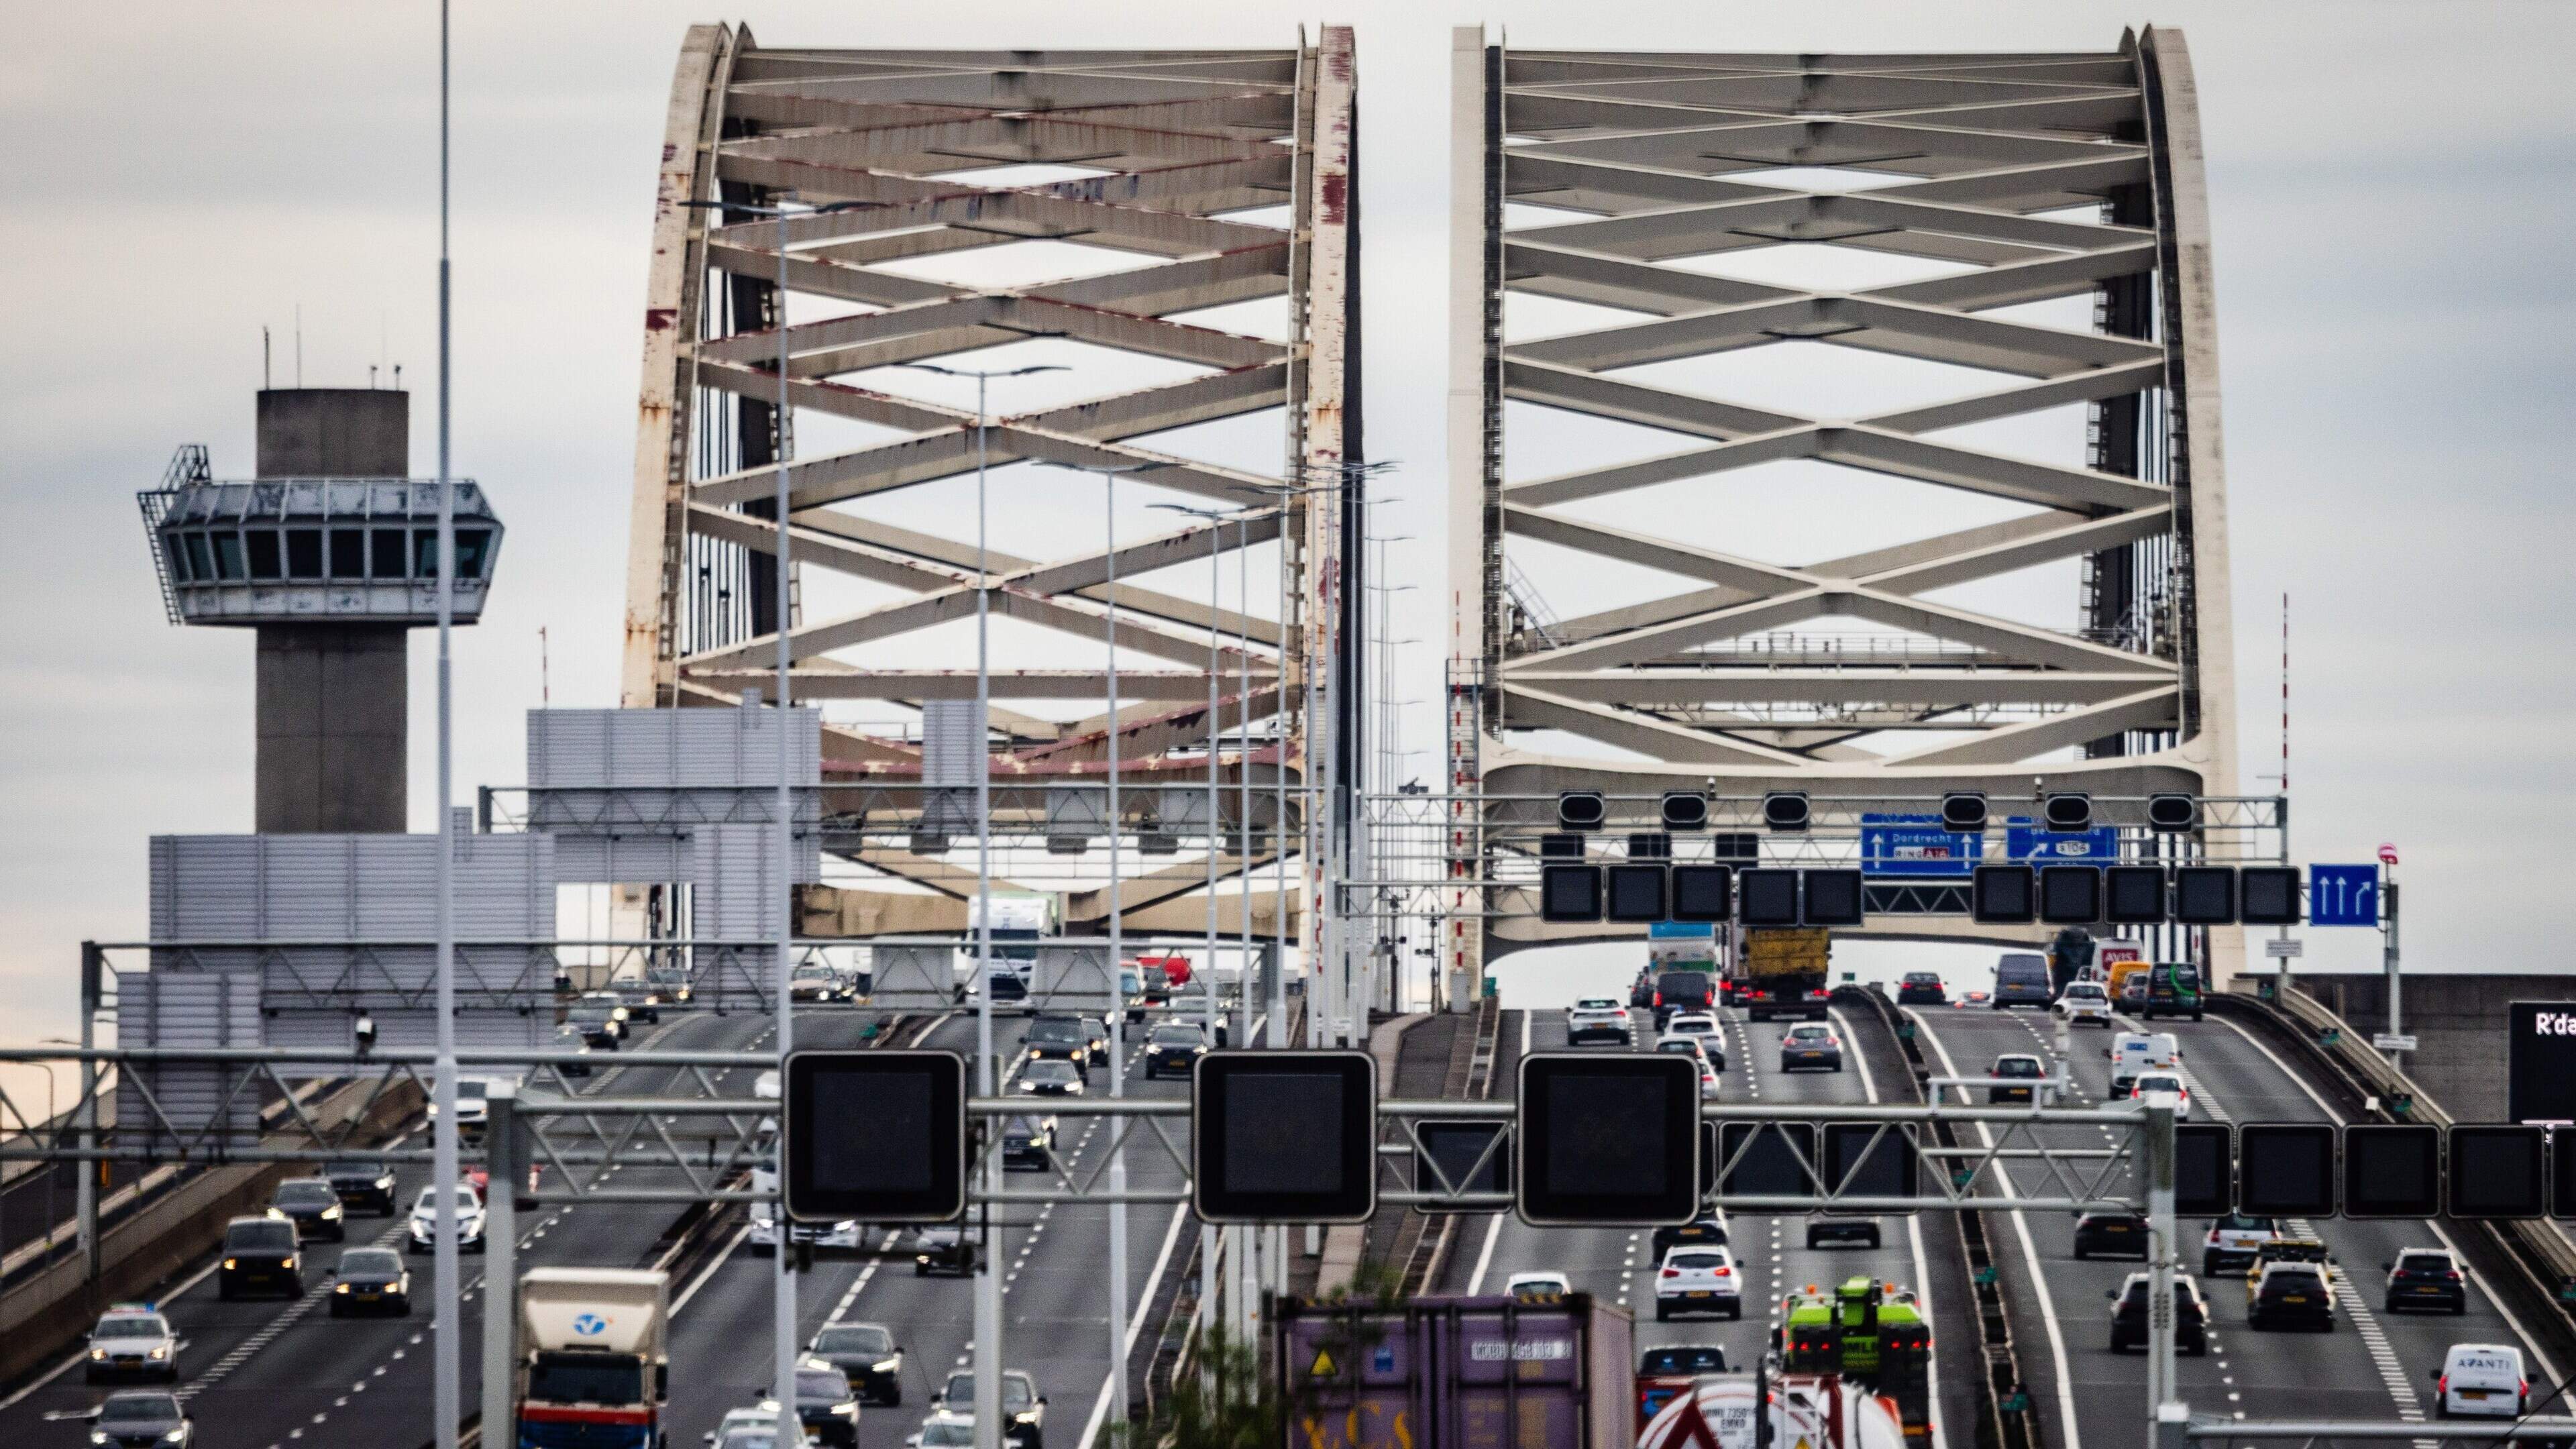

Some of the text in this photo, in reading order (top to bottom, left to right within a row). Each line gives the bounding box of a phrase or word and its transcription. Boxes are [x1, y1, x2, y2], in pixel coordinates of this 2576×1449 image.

[1892, 833, 1951, 843] Dordrecht
[1894, 849, 1922, 859] RING
[2458, 1358, 2511, 1369] AVANTI
